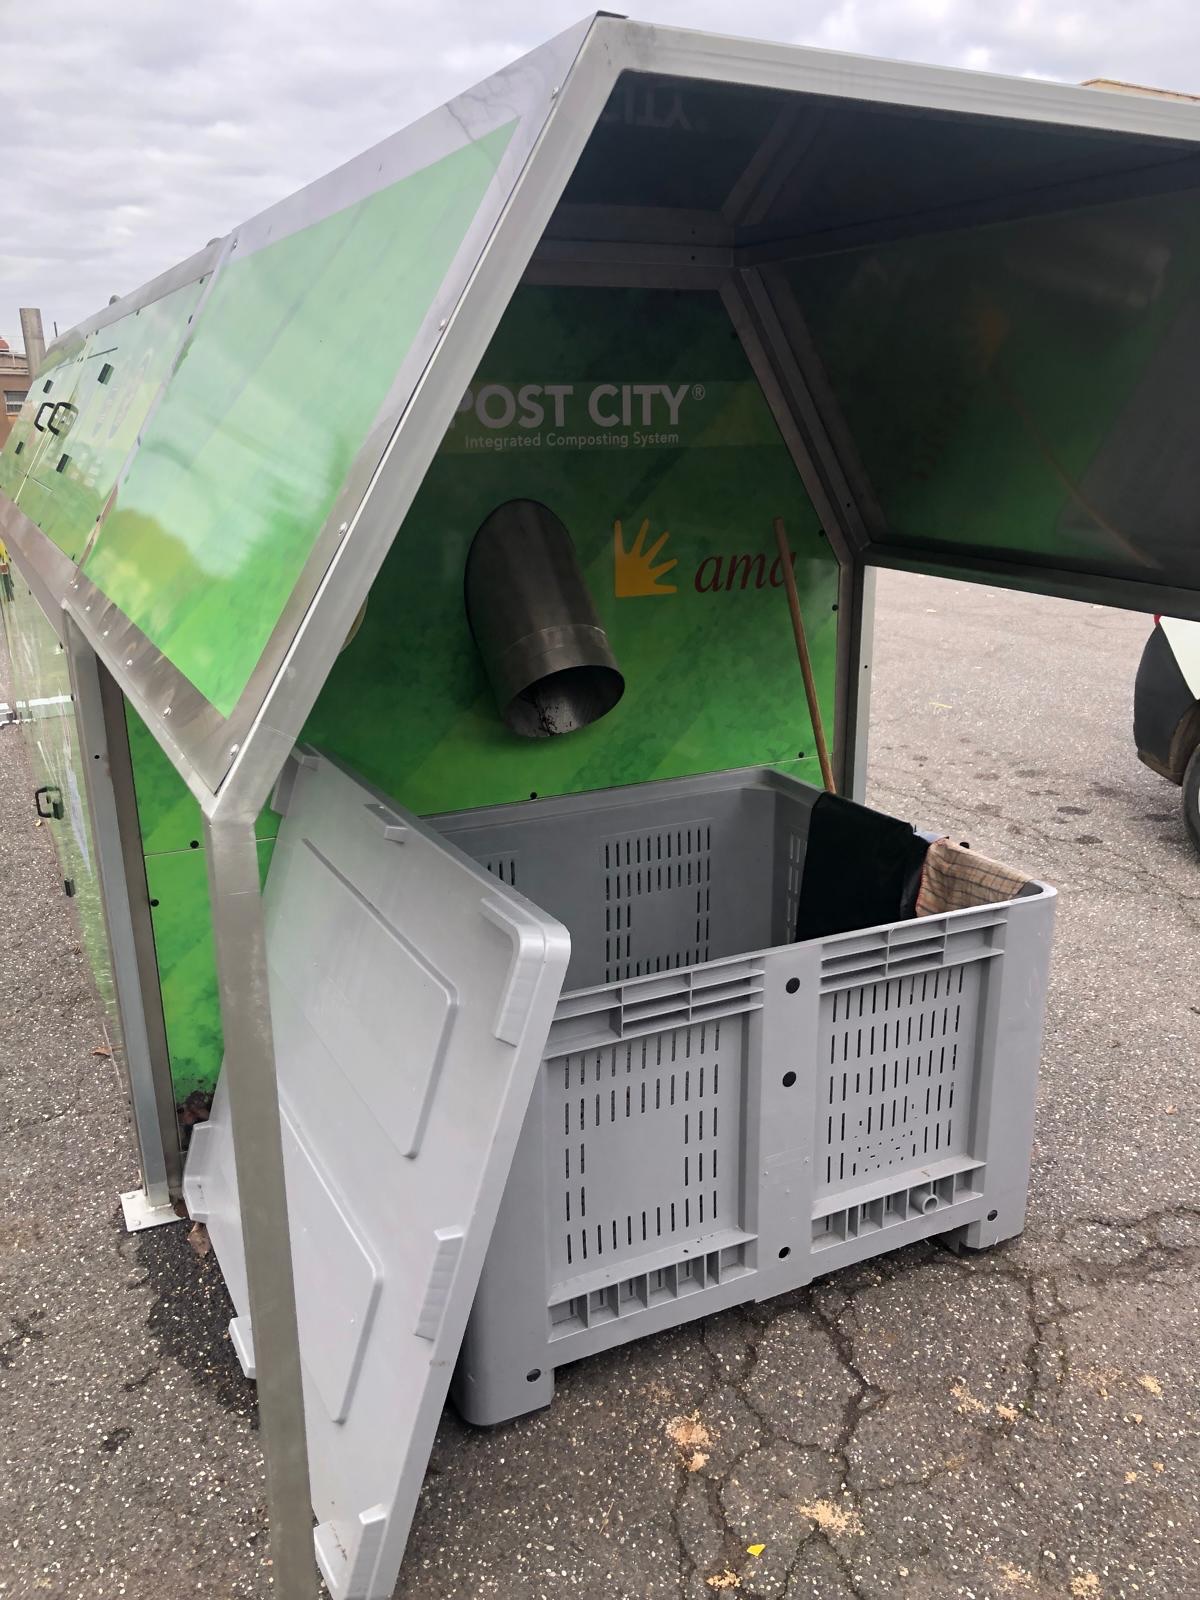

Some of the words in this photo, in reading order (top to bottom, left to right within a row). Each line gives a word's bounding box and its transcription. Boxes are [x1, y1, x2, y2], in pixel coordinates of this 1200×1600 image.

[465, 432, 541, 451] Integrated
[546, 432, 629, 449] Composting
[633, 431, 679, 448] System
